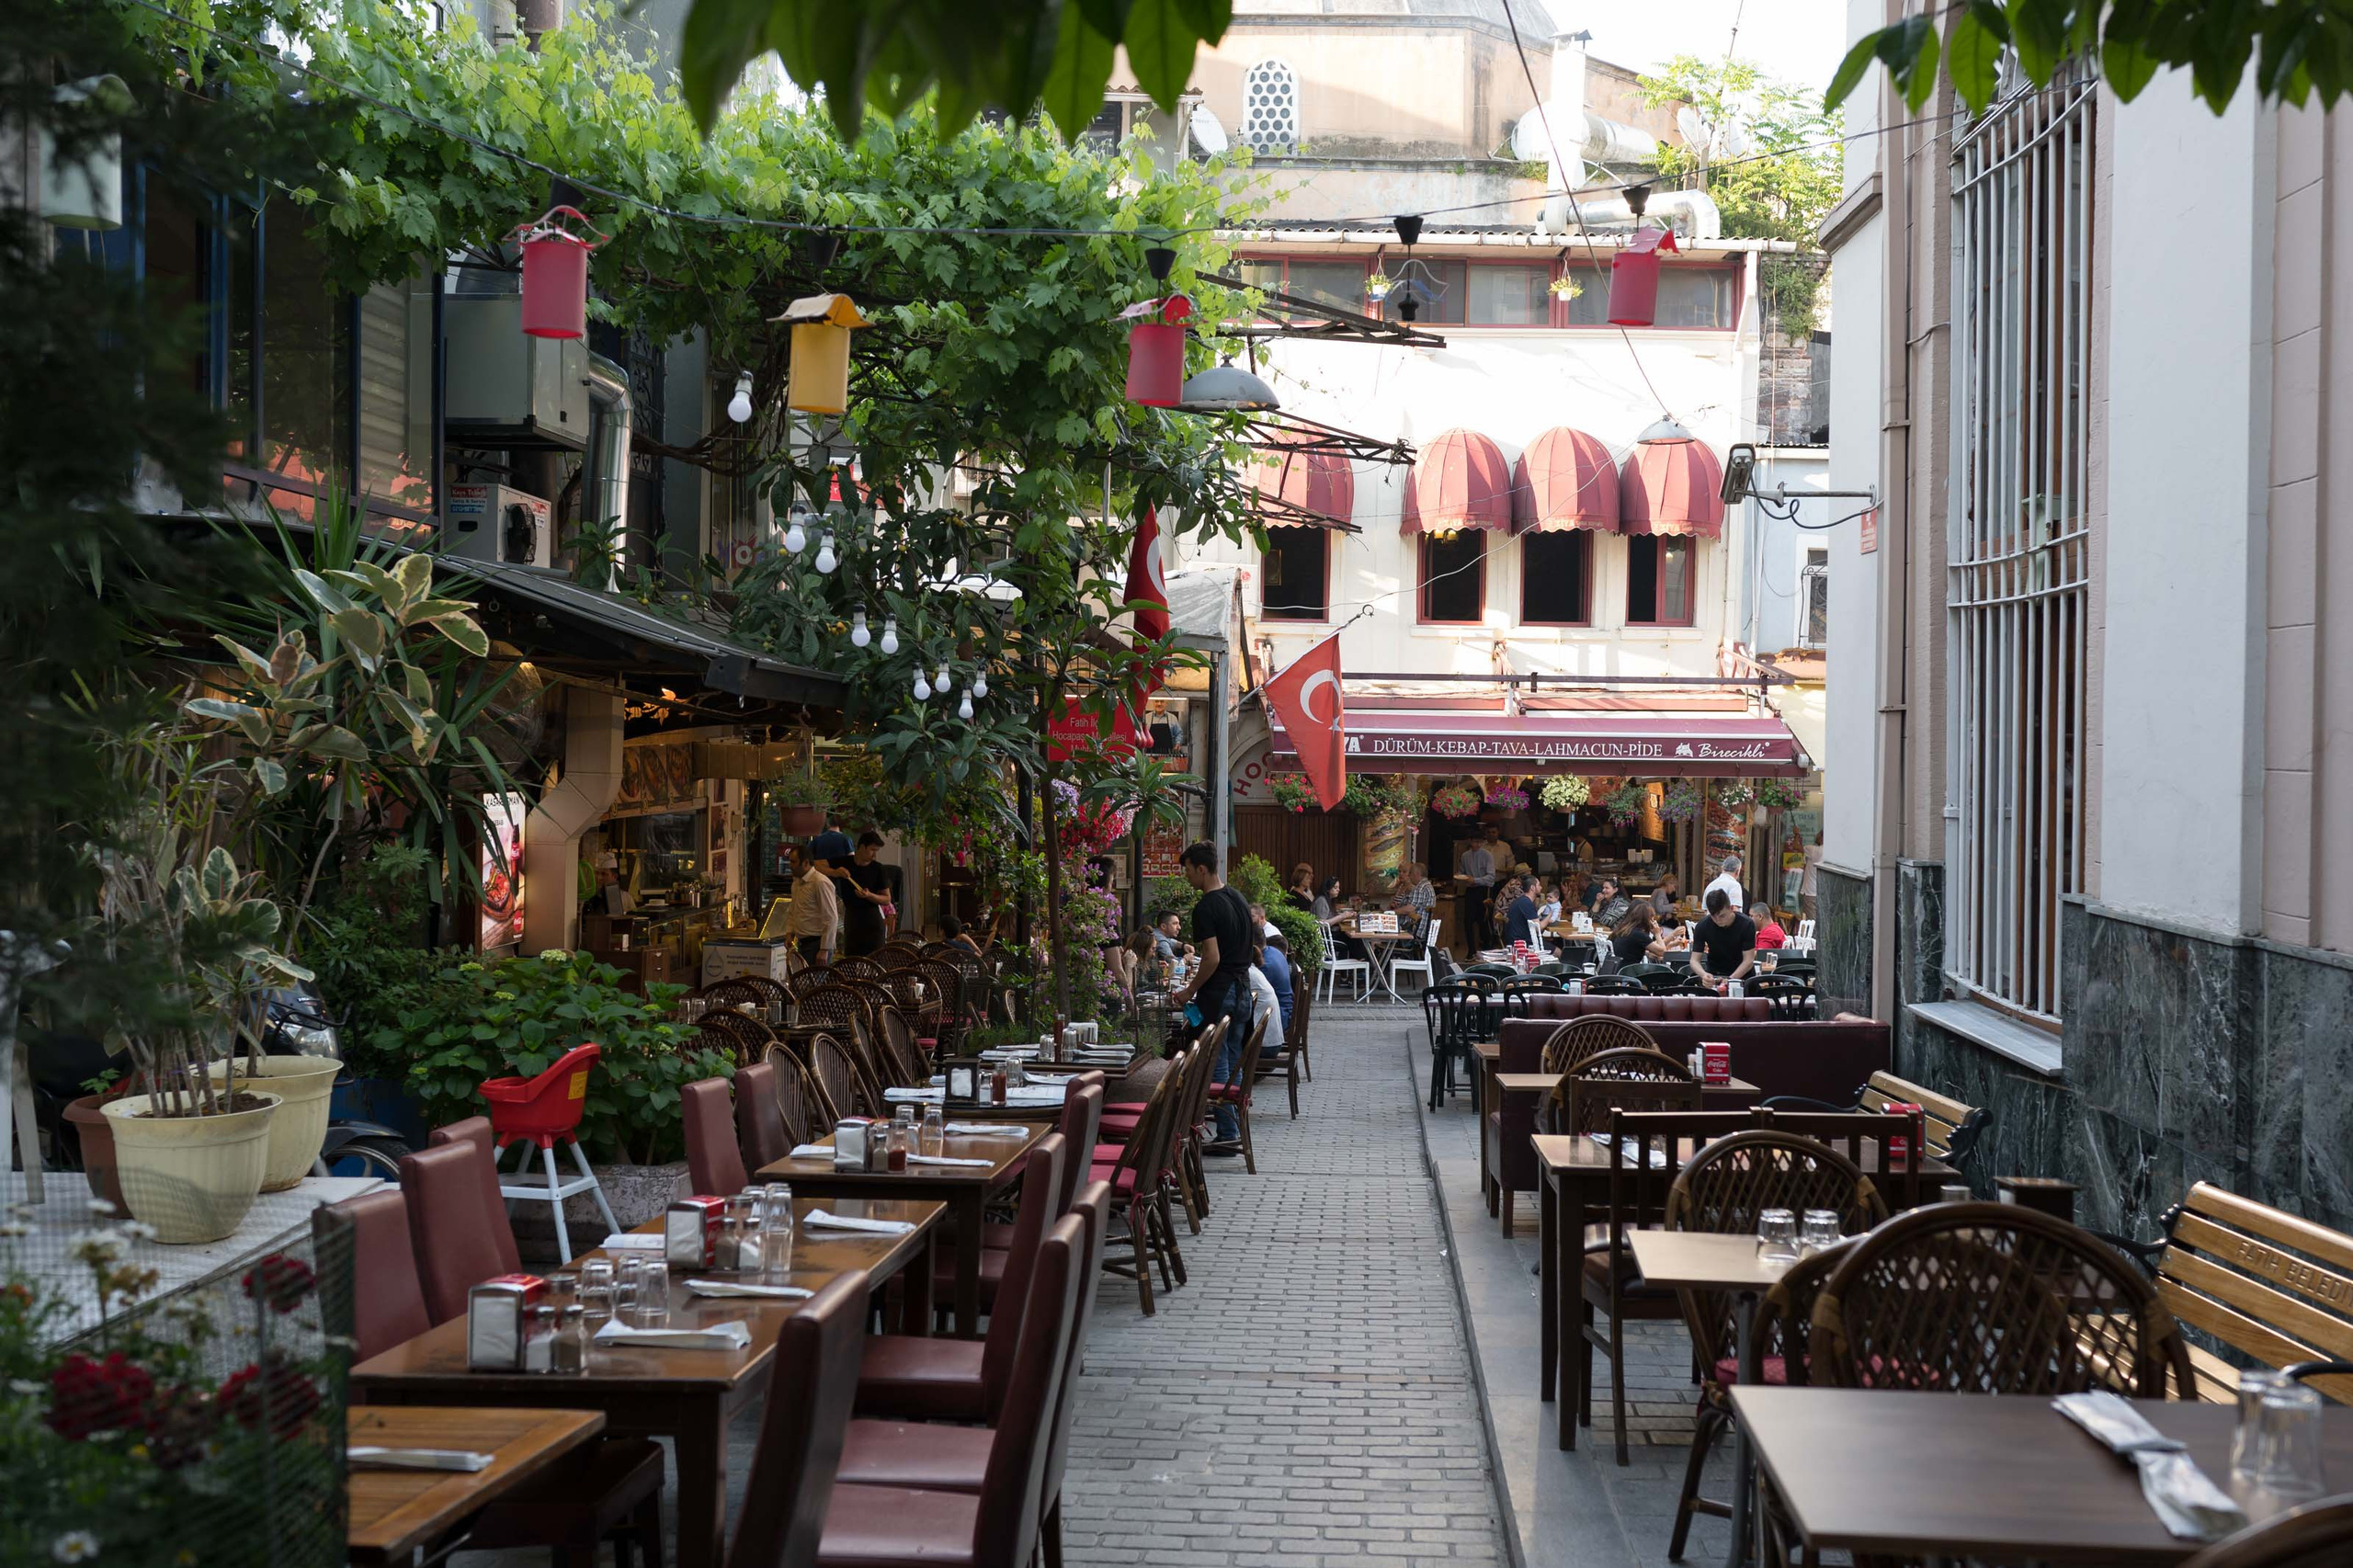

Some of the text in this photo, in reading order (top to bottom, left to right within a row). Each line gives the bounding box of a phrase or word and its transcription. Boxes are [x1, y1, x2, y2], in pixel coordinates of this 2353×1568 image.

[1070, 717, 1089, 727] Fatih
[1052, 731, 1086, 743] Hocapaş
[1373, 737, 1663, 756] DÜRÜM-KEBAP-TAVA-LAHMACUN-PİDE
[1698, 743, 1765, 758] Birecikli
[2284, 1261, 2353, 1308] BELEDI
